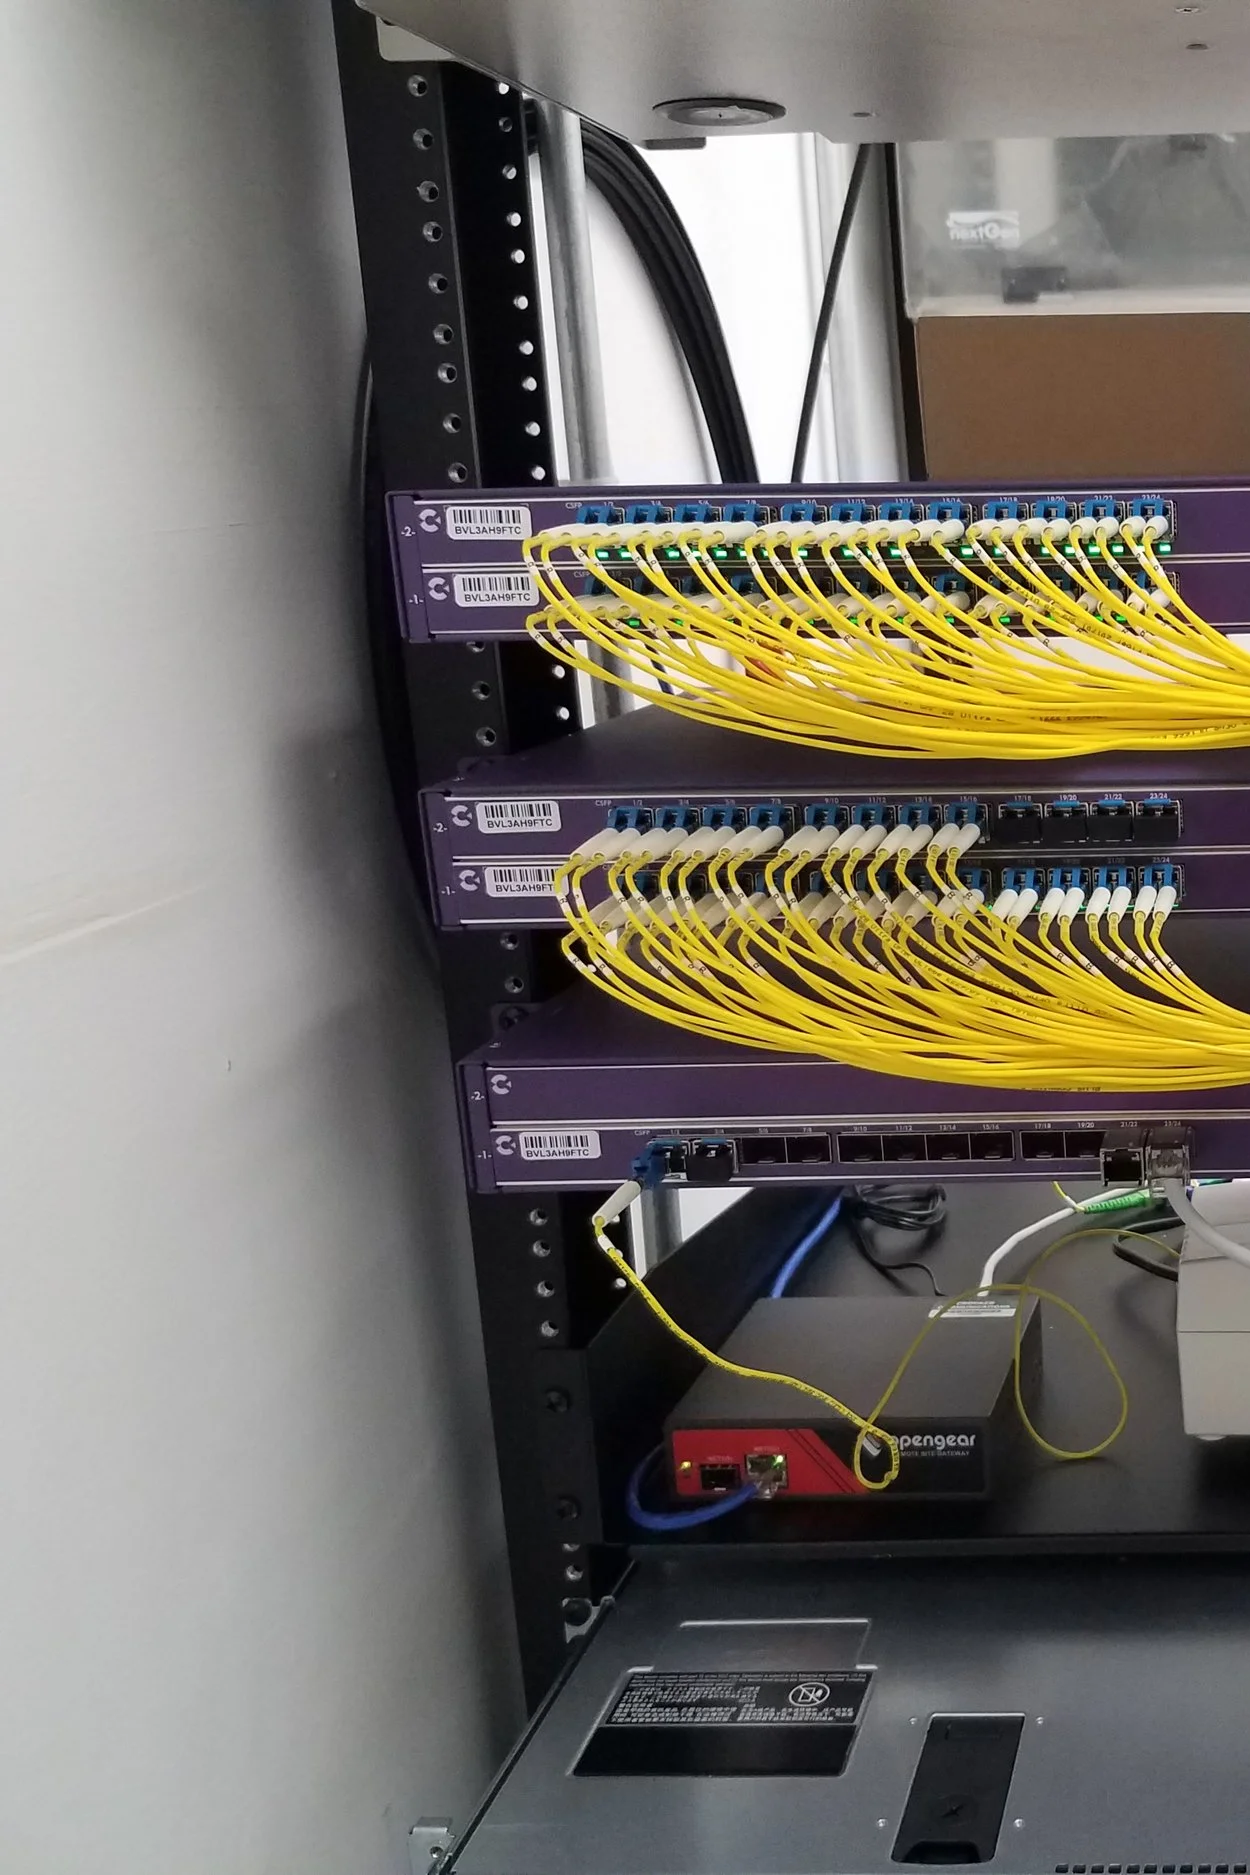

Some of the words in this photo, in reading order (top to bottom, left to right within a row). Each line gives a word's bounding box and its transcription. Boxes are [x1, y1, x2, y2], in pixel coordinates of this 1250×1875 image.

[455, 526, 522, 535] BVL3AH9FTC
[464, 593, 531, 602] BVL3AH9FTC
[487, 819, 553, 829] BVL3AH9FTC
[495, 884, 553, 892] BVL3AH9FT
[526, 1149, 589, 1158] BVL3AH9FTC
